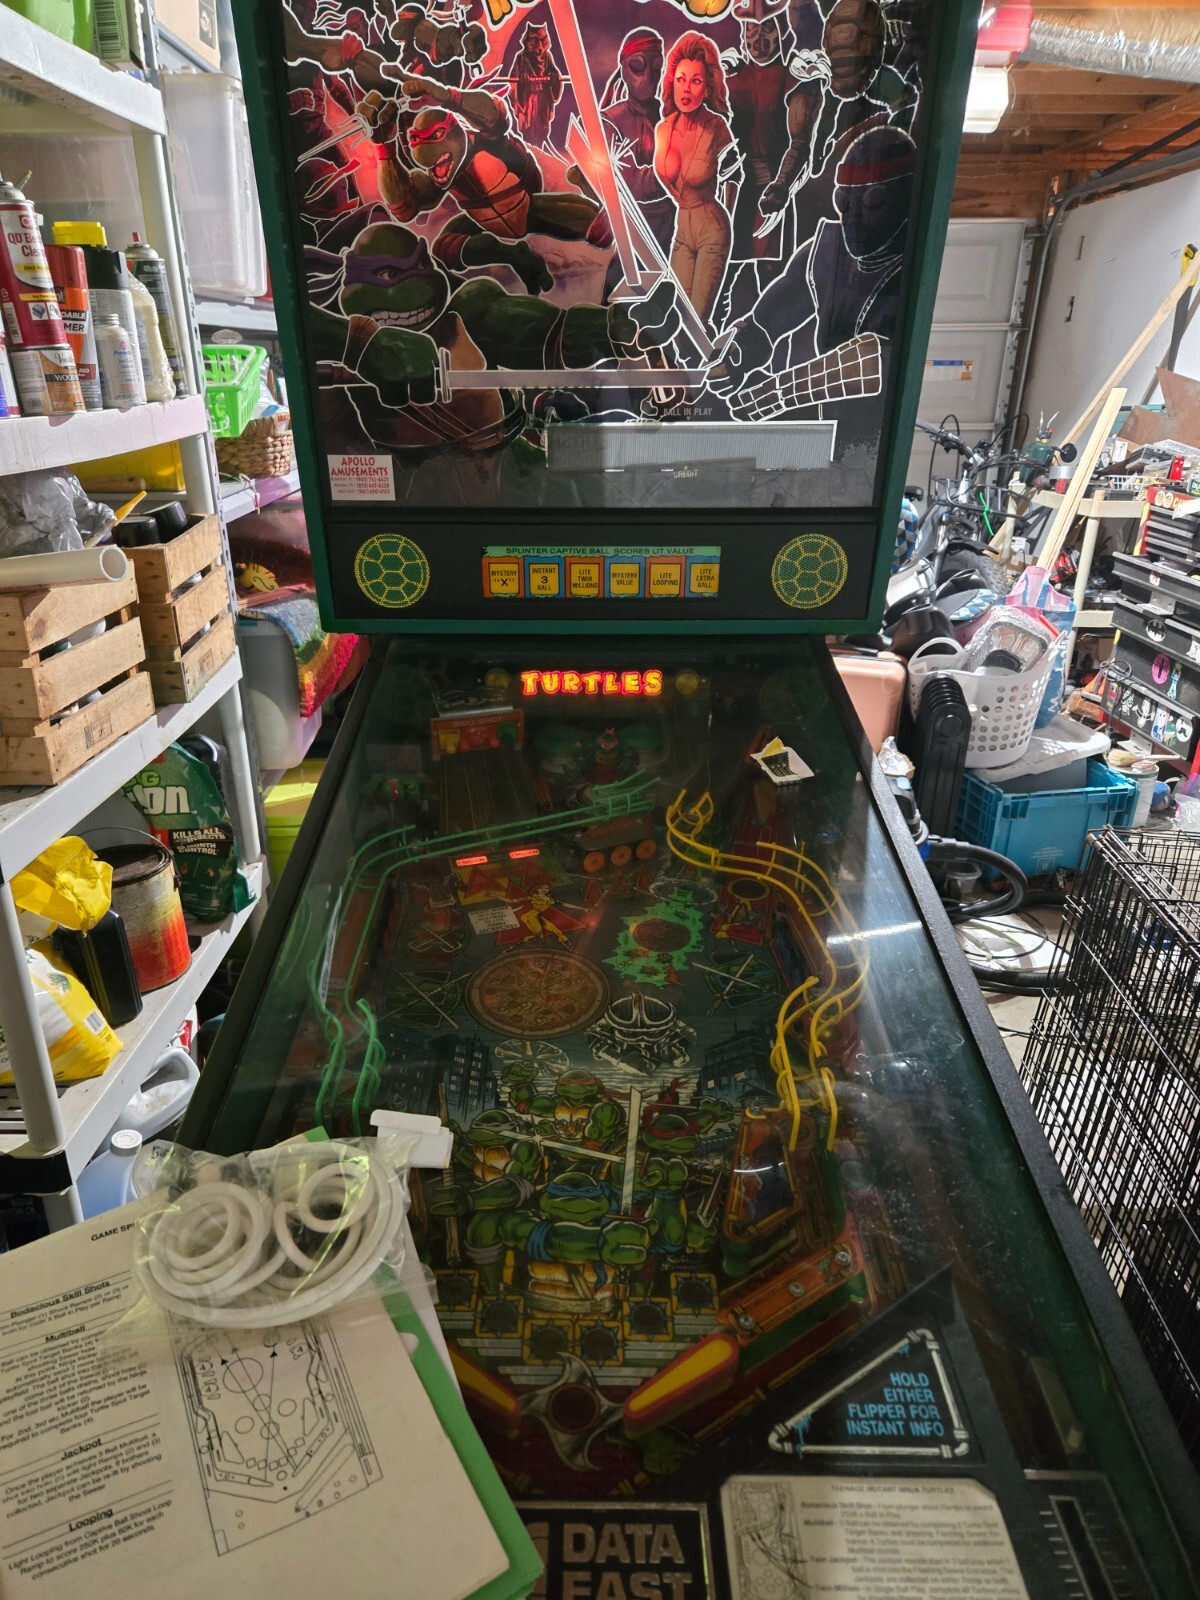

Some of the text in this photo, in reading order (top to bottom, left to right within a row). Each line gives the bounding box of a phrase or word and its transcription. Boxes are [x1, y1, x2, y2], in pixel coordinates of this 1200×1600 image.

[61, 311, 86, 320] DABLE
[64, 323, 85, 332] MER
[663, 408, 713, 416] BALL IN PLAY
[341, 456, 375, 466] APOLLO
[331, 467, 389, 476] AMUSEMENTS
[506, 547, 695, 555] SPLINTER CAPTIVE BALL SCORES LIT VALUE
[541, 575, 549, 584] 3
[521, 669, 663, 696] TURTLES
[91, 1227, 119, 1241] GAME
[62, 1290, 82, 1302] Skill
[84, 1280, 110, 1295] Shots
[45, 1325, 86, 1343] Multiball
[890, 1372, 929, 1387] HOLD
[884, 1388, 934, 1403] EITHER
[848, 1403, 940, 1419] FLIPPER FOR
[847, 1419, 944, 1437] INSTANT INFO
[61, 1438, 102, 1461] Jackpot
[69, 1509, 114, 1532] Looping
[563, 1523, 685, 1564] DATA
[563, 1571, 693, 1600] EAST
